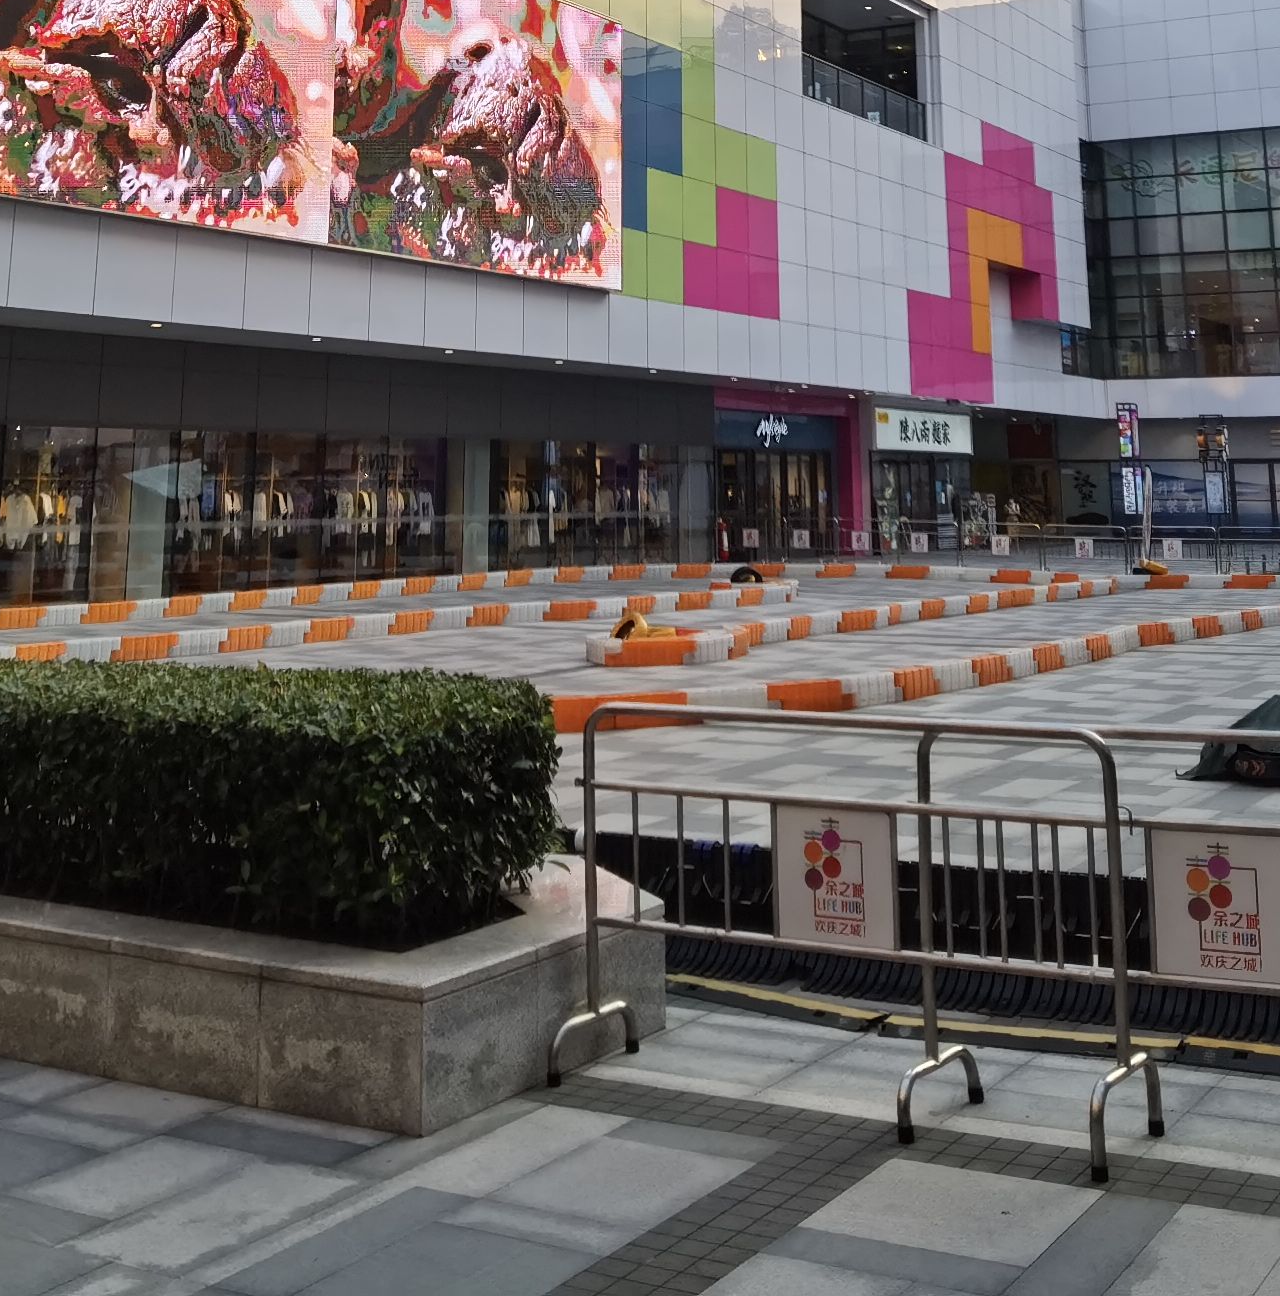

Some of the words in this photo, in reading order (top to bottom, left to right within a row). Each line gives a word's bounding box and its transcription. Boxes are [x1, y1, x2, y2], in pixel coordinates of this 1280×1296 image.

[816, 898, 838, 912] LIFE
[841, 900, 863, 915] HUB
[1213, 910, 1260, 930] 余之城
[1203, 929, 1229, 945] LIFE
[1232, 931, 1258, 947] HUB
